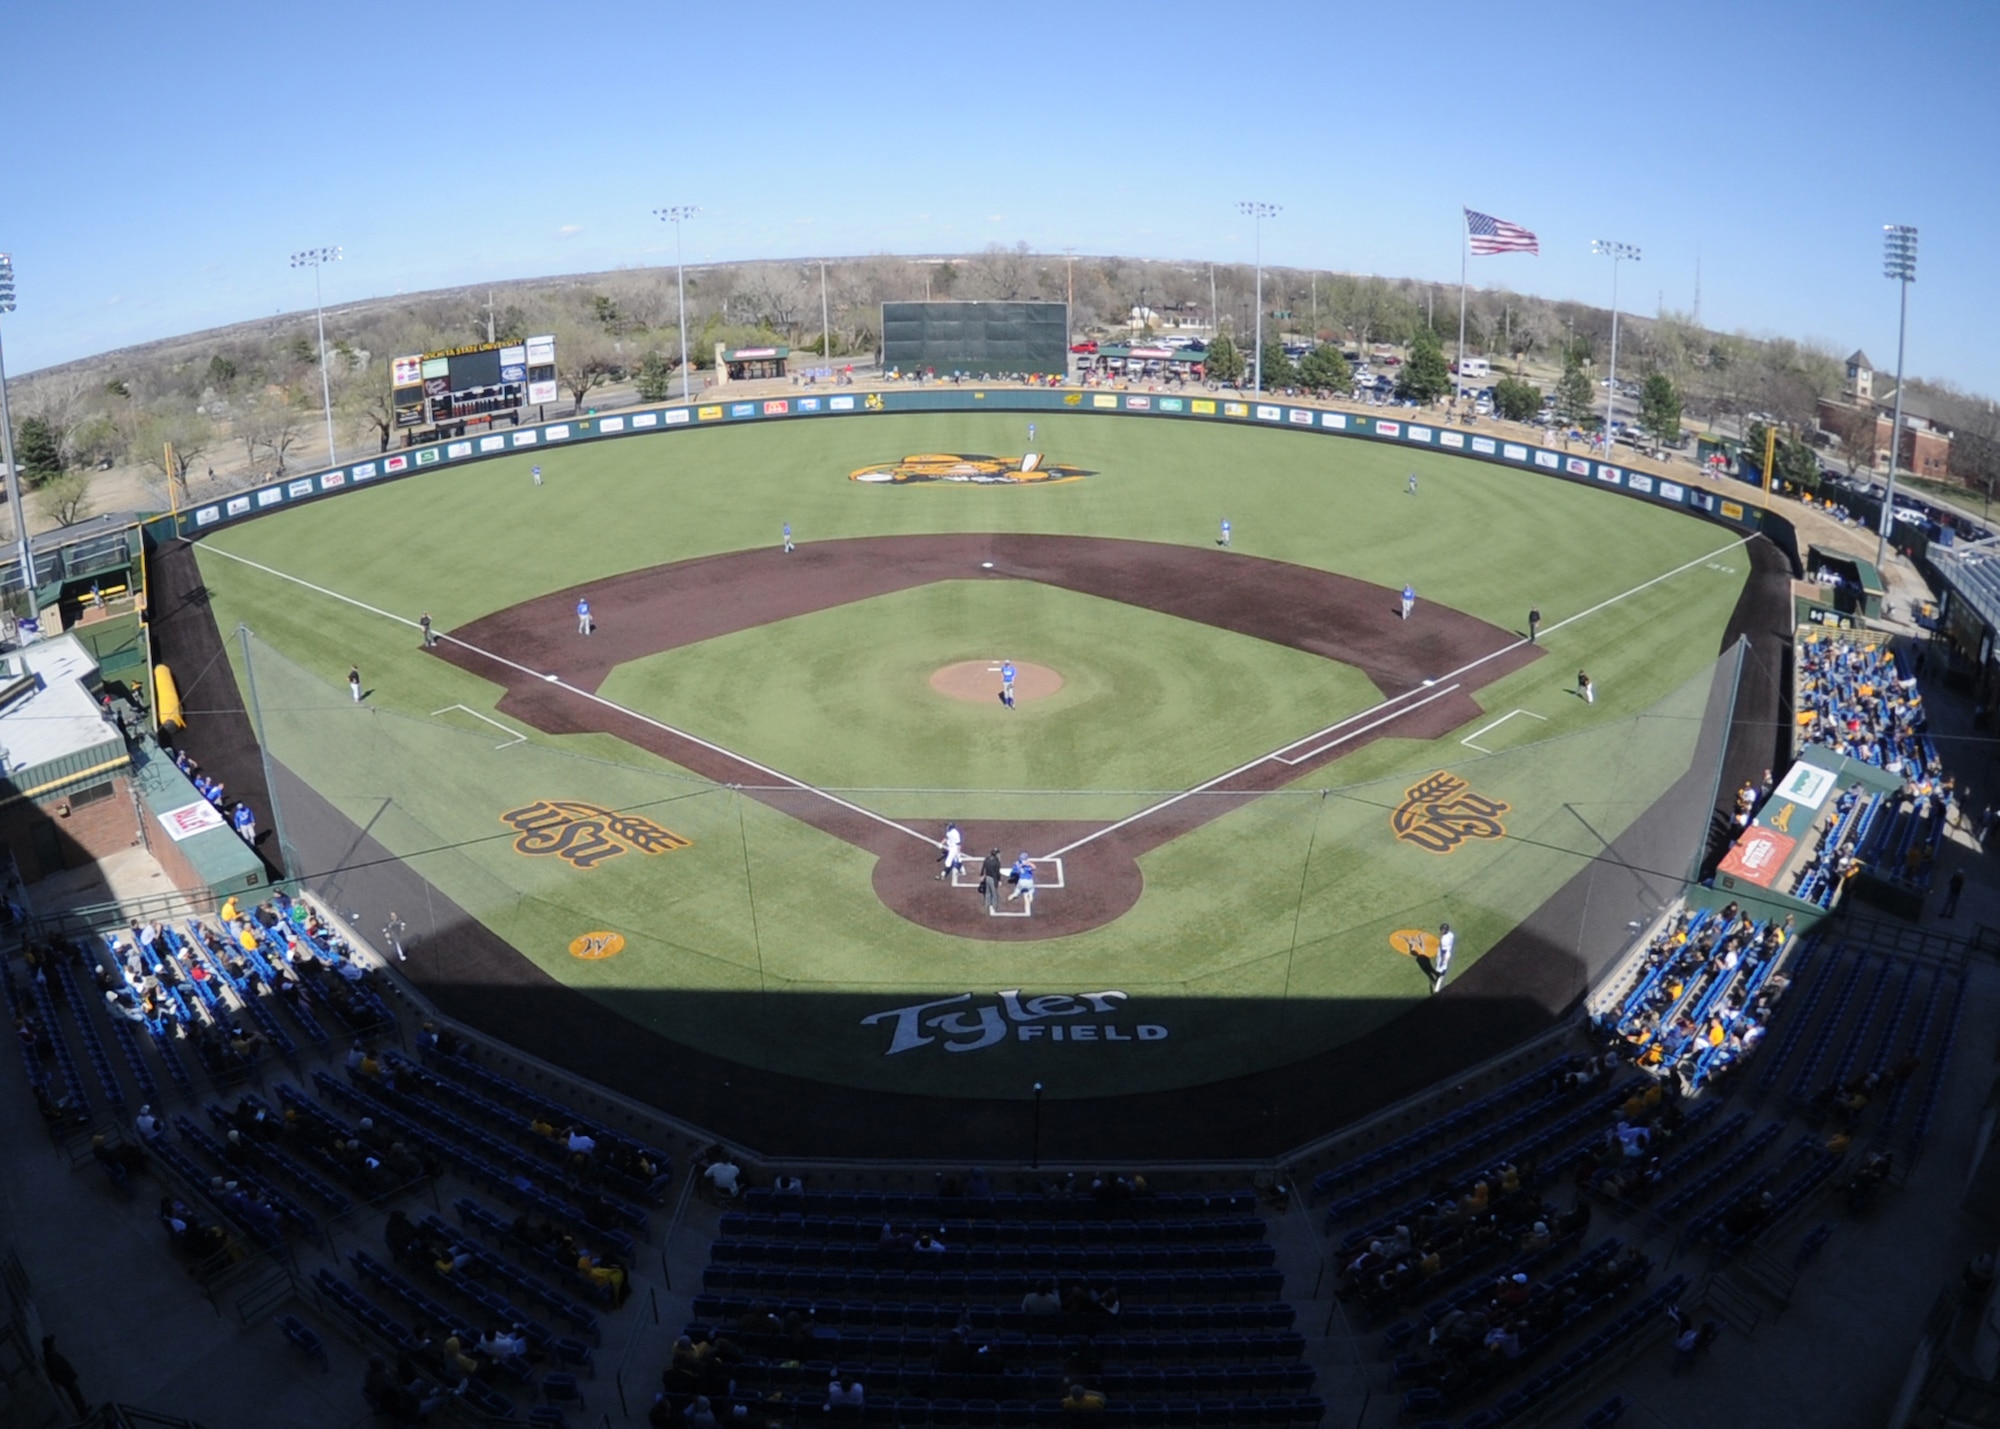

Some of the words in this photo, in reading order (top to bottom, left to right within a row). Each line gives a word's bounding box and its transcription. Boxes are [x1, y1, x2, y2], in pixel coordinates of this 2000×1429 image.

[455, 344, 478, 356] STATE
[479, 338, 523, 352] UNIVERSITY
[860, 989, 1128, 1056] Tyler
[1018, 1024, 1169, 1041] FIELD
